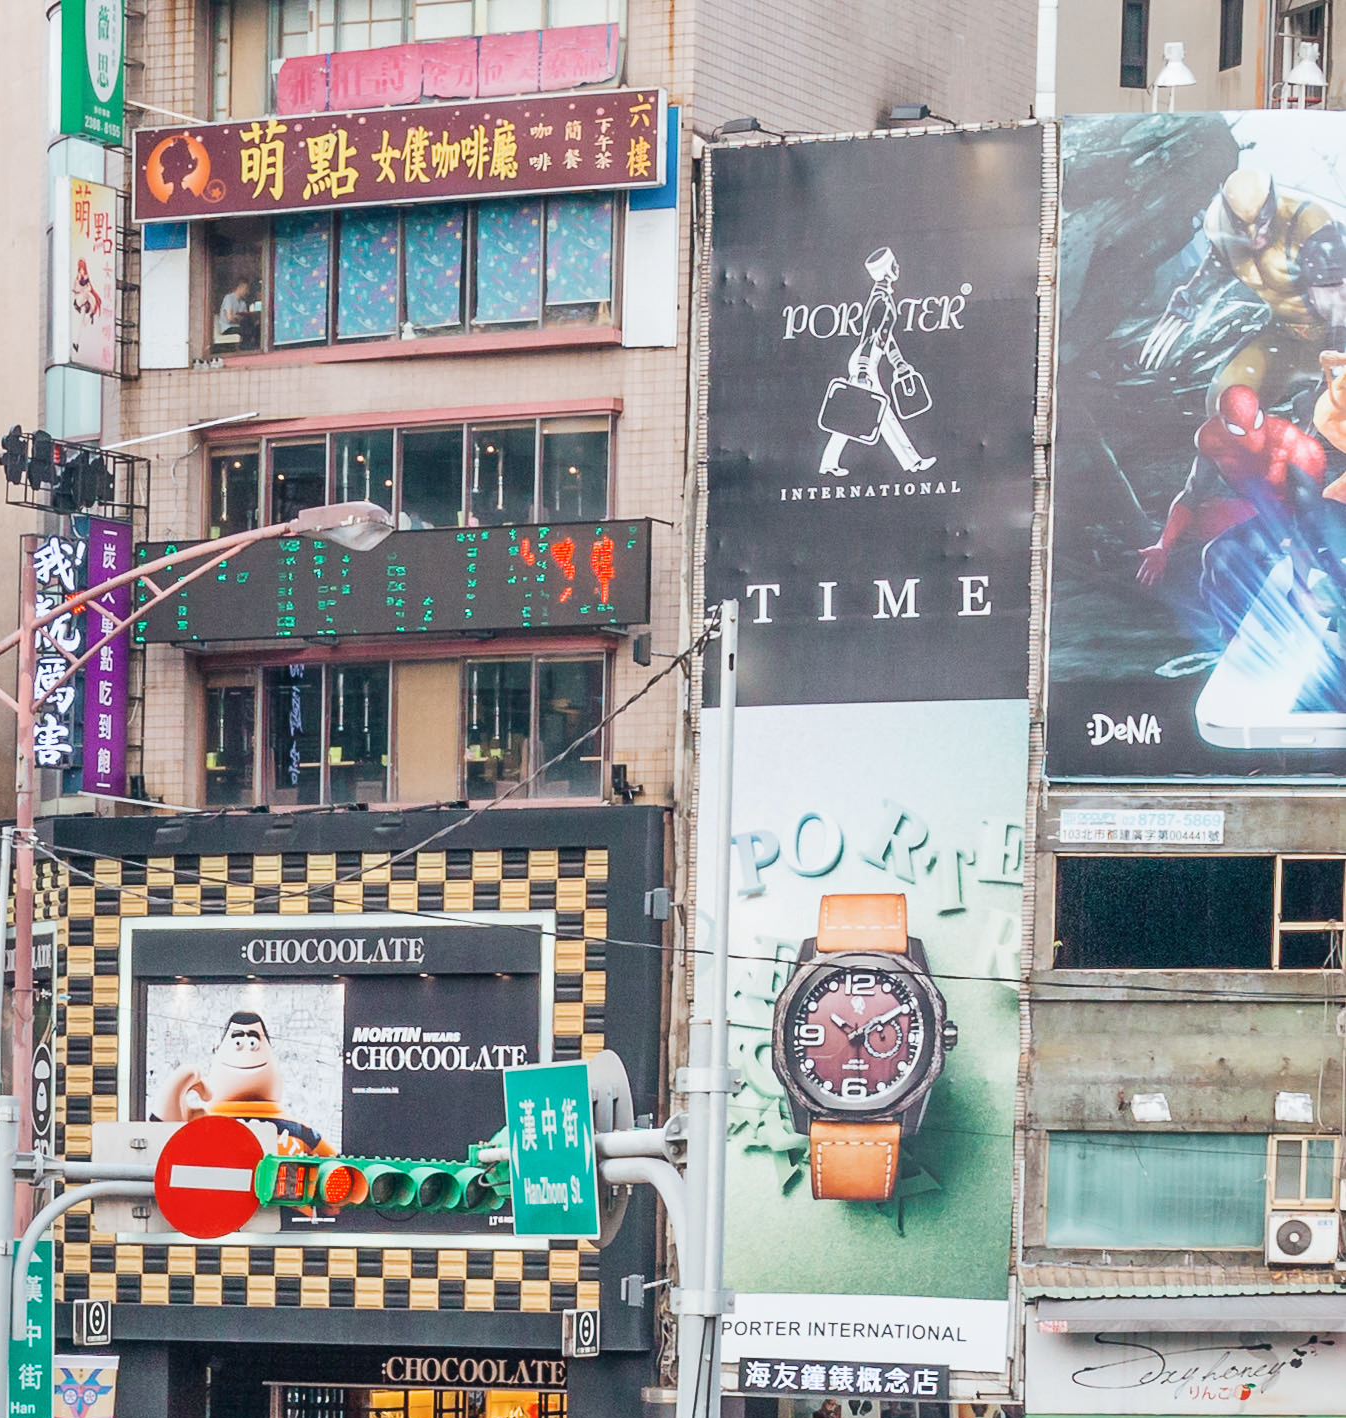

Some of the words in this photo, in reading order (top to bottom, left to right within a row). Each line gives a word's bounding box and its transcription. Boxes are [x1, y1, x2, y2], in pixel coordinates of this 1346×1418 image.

[529, 123, 553, 172] 咖啡
[562, 120, 583, 171] 簡餐
[595, 117, 614, 169] 下午茶
[626, 94, 653, 178] 六樓
[240, 119, 360, 202] 萌點
[371, 119, 519, 185] 女僕咖啡廳
[74, 184, 114, 256] 萌點
[782, 293, 967, 341] PORTER
[780, 480, 962, 502] INTERNATIONAL
[745, 574, 993, 625] TIME
[1137, 812, 1222, 828] 8787-5869
[843, 974, 878, 996] 12
[351, 1026, 423, 1044] MORTIN
[423, 1031, 462, 1044] WEARS
[798, 1023, 826, 1047] 9
[841, 1078, 868, 1098] 6
[519, 1097, 579, 1152] 漢中街
[523, 1176, 569, 1212] HanZhong
[17, 1275, 44, 1391] 漢中街
[721, 1319, 801, 1338] PORTER
[807, 1321, 967, 1343] INTERNATIONAL
[744, 1359, 940, 1397] 海友鐘錶概念店
[1189, 1385, 1230, 1400] りんご
[10, 1402, 36, 1414] Han
